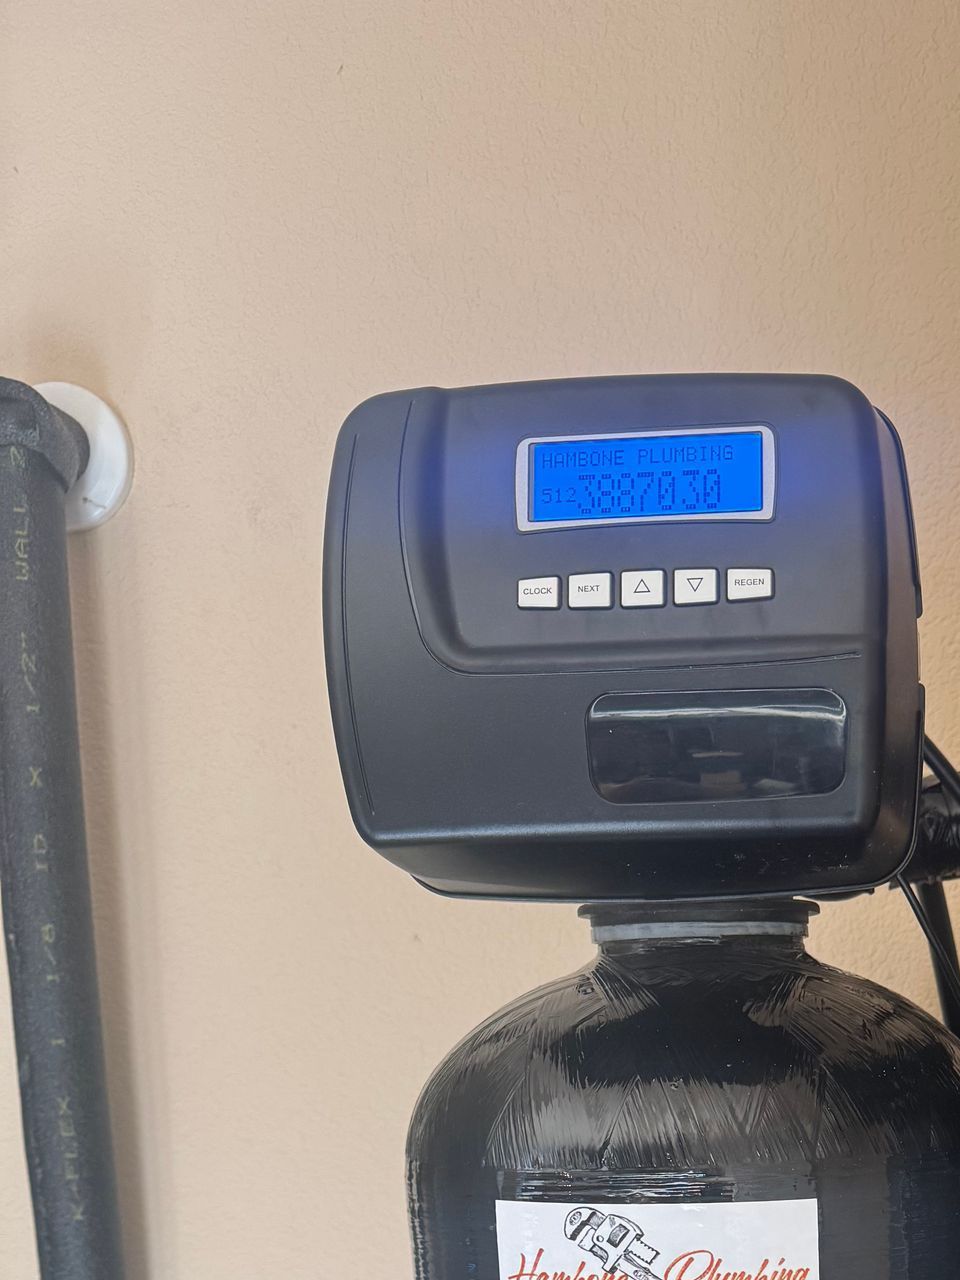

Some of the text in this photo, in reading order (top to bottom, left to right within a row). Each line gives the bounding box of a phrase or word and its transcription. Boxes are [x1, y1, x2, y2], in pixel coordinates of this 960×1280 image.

[542, 445, 733, 469] HAMBONE PLUMBING
[734, 577, 765, 587] REGEN
[523, 586, 552, 596] CLOCK
[577, 585, 600, 594] NEXT
